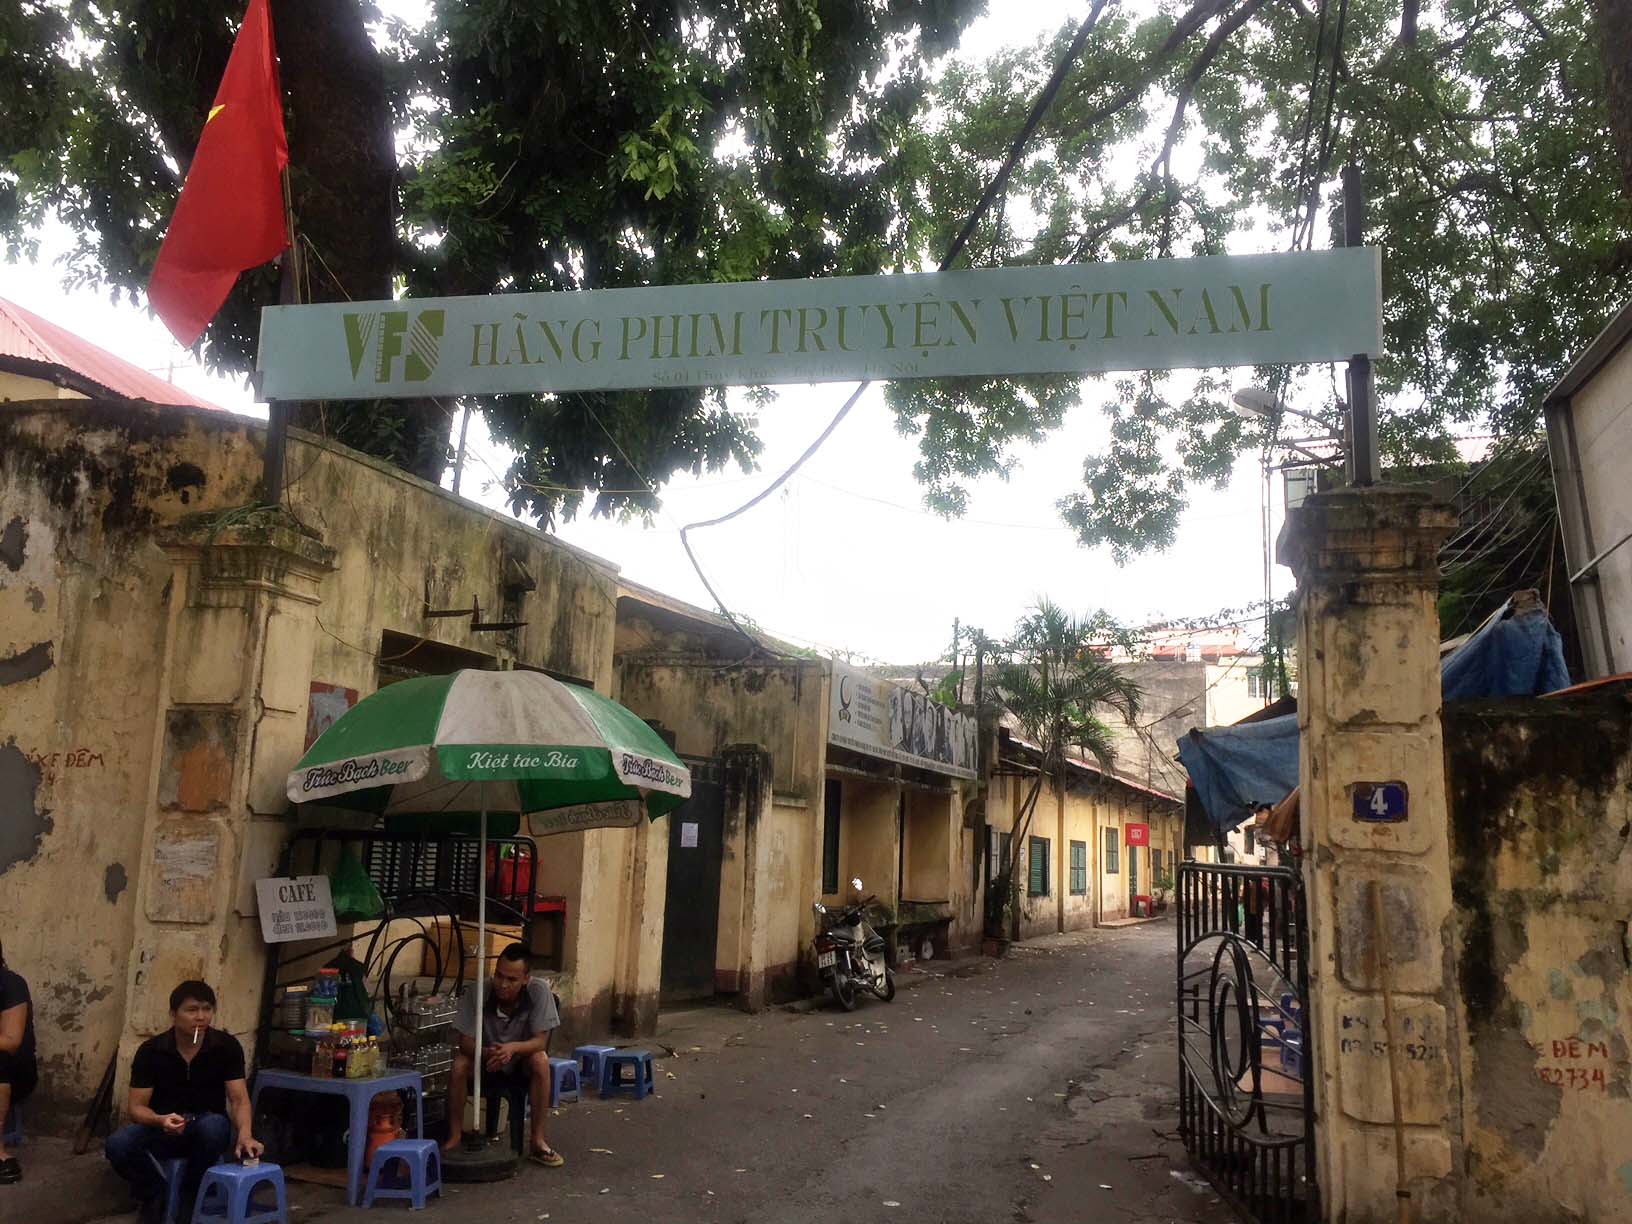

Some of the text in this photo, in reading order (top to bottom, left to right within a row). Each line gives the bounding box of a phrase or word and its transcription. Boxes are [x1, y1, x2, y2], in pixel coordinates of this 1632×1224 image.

[470, 283, 1272, 366] HÃNG PHIM TRUYỆN VIỆT NAM
[343, 309, 445, 382] VFS
[380, 757, 414, 777] Beer
[467, 751, 509, 772] Kiệt
[544, 751, 579, 768] Bia
[1370, 787, 1389, 816] 4
[279, 878, 316, 903] CAFÉ
